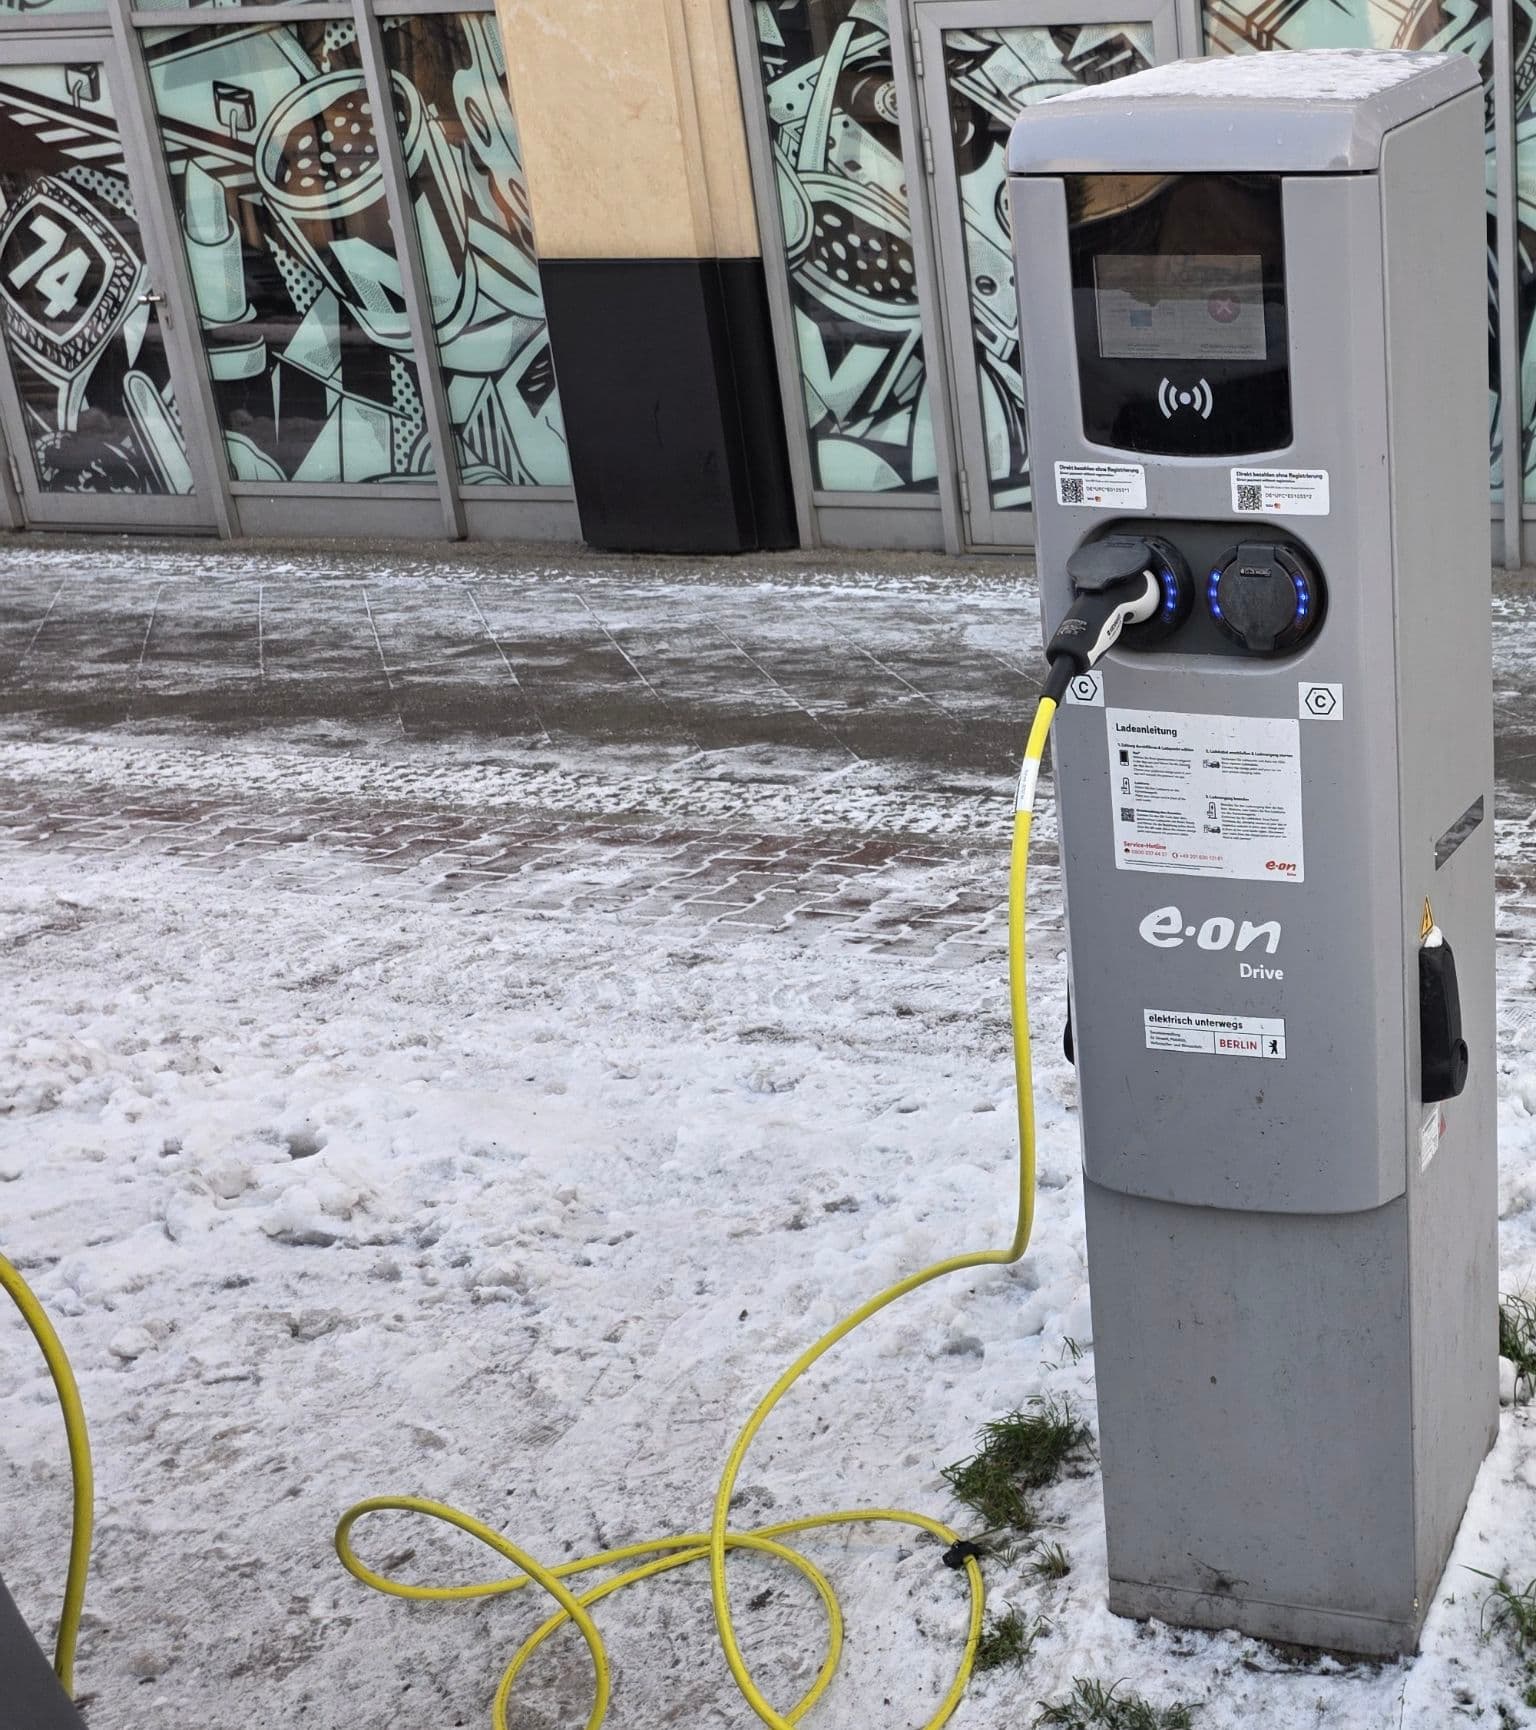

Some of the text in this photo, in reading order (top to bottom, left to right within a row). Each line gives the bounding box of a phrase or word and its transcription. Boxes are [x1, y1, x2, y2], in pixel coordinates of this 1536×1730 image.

[8, 215, 91, 319] 74
[1289, 472, 1323, 480] Registrierung
[1078, 681, 1089, 694] C
[1315, 695, 1326, 708] C
[1115, 722, 1177, 738] Ladeanleitung
[1239, 963, 1284, 981] Drive
[1149, 1014, 1243, 1031] elektrisch unterwegs
[1219, 1039, 1257, 1050] BERLIN
